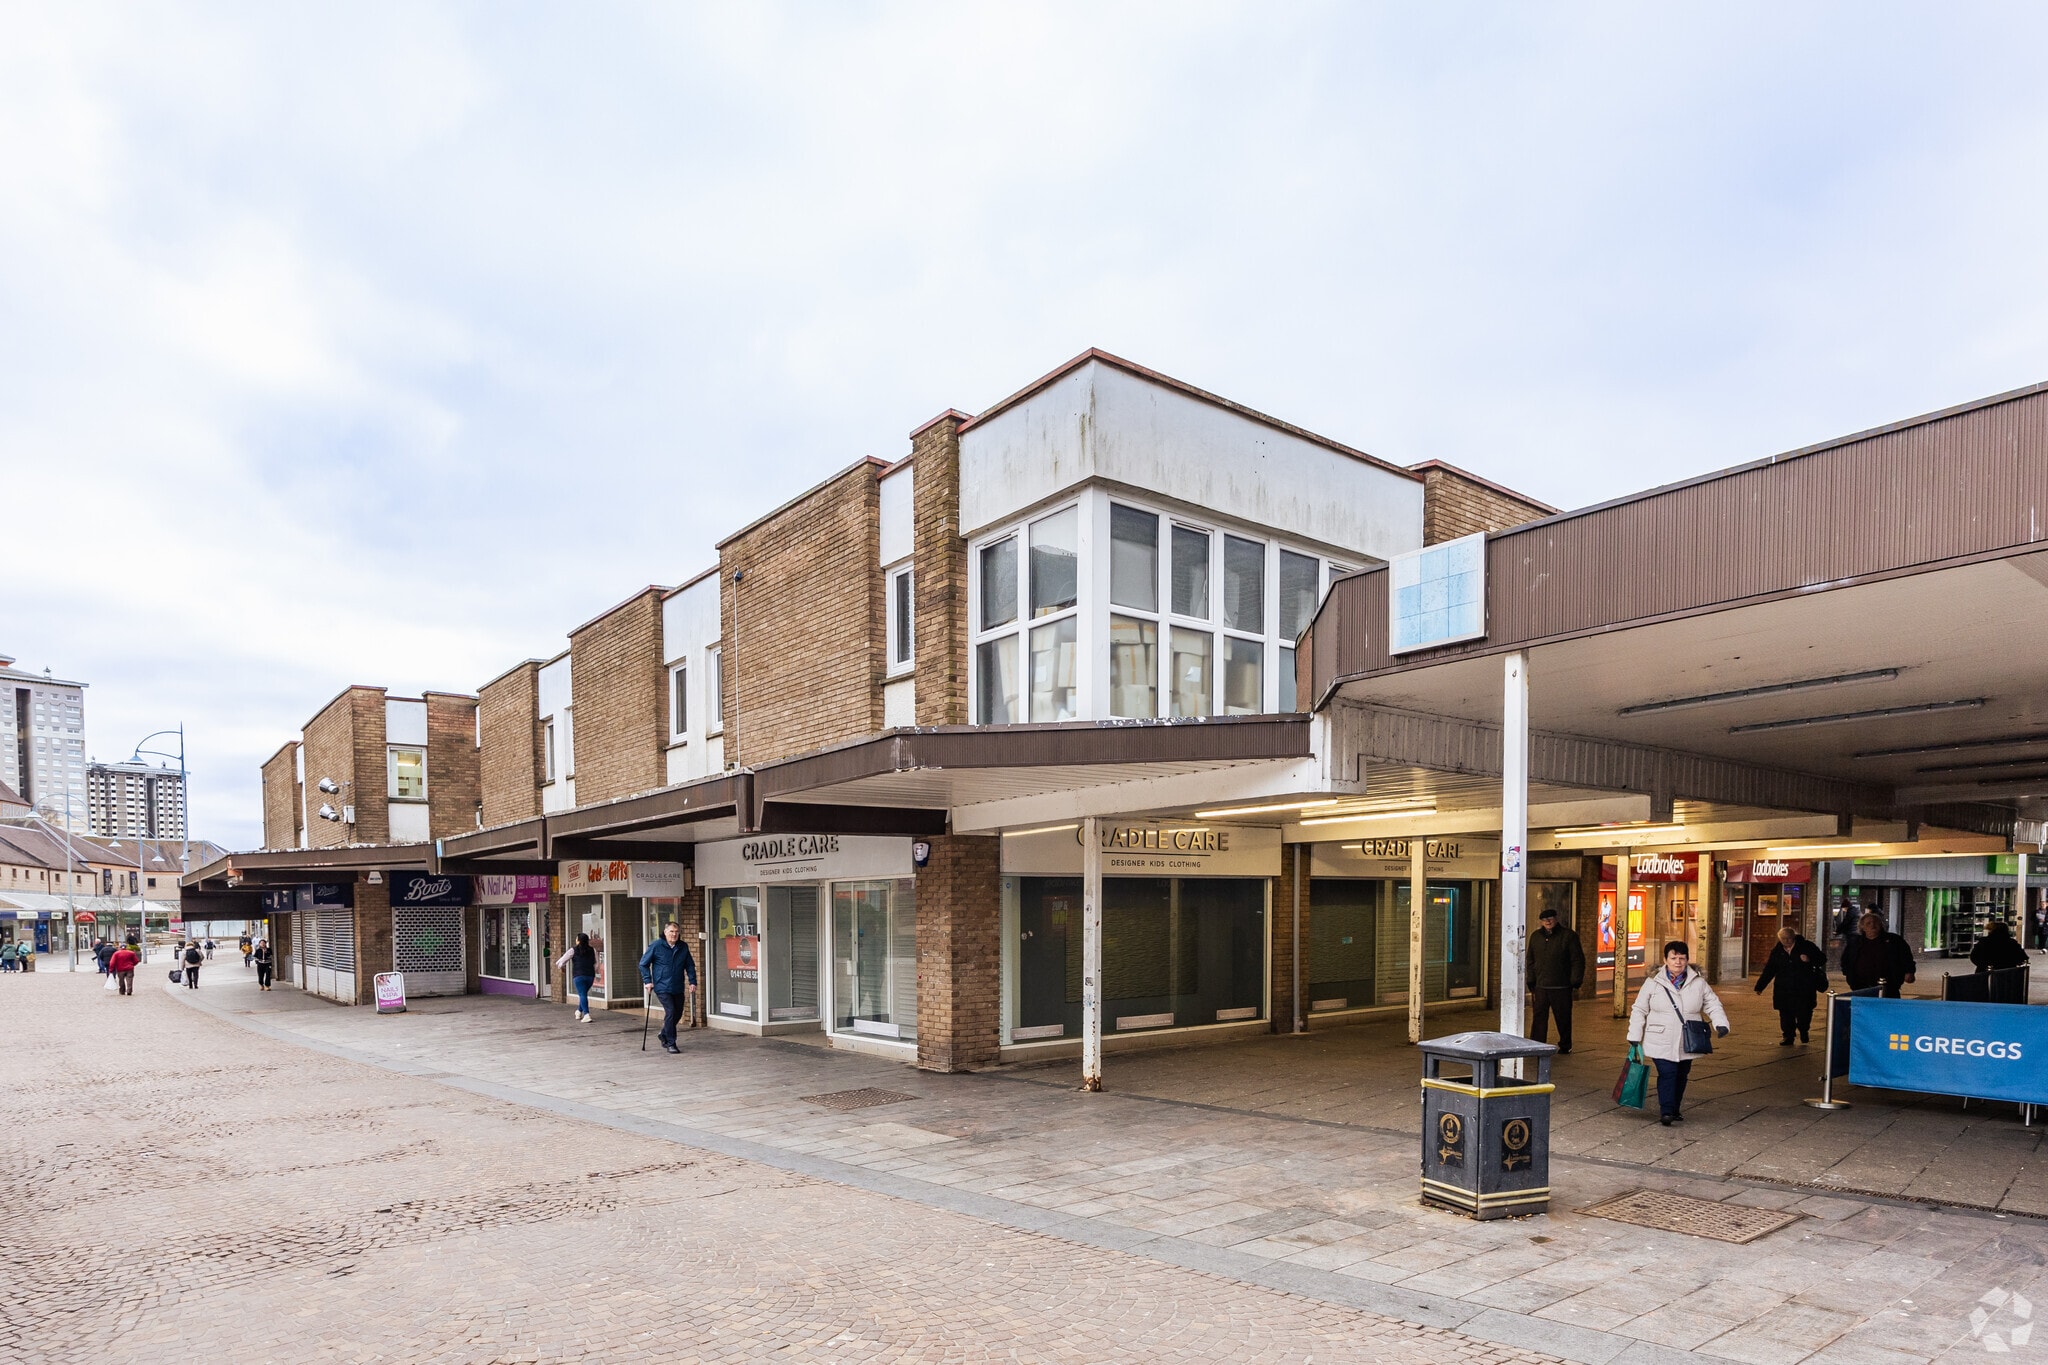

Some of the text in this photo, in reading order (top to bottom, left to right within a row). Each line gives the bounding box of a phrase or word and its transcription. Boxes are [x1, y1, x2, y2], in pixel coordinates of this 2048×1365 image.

[742, 834, 839, 861] CRADLE CARE
[1173, 830, 1230, 851] CARE
[1361, 840, 1464, 859] CRADL CARE
[760, 868, 780, 876] DESIGNER
[794, 865, 817, 874] CLOTHING
[1111, 859, 1146, 867] DESIGNER
[1169, 860, 1201, 868] CLOTHING
[1636, 853, 1685, 875] Ladbrokes
[1752, 859, 1789, 877] Ladbrokes
[404, 877, 452, 901] Boots
[487, 876, 500, 896] Nail
[502, 876, 513, 895] Art
[732, 924, 754, 937] TO LET
[730, 969, 742, 979] 0141
[1914, 1035, 2022, 1060] GREGGS
